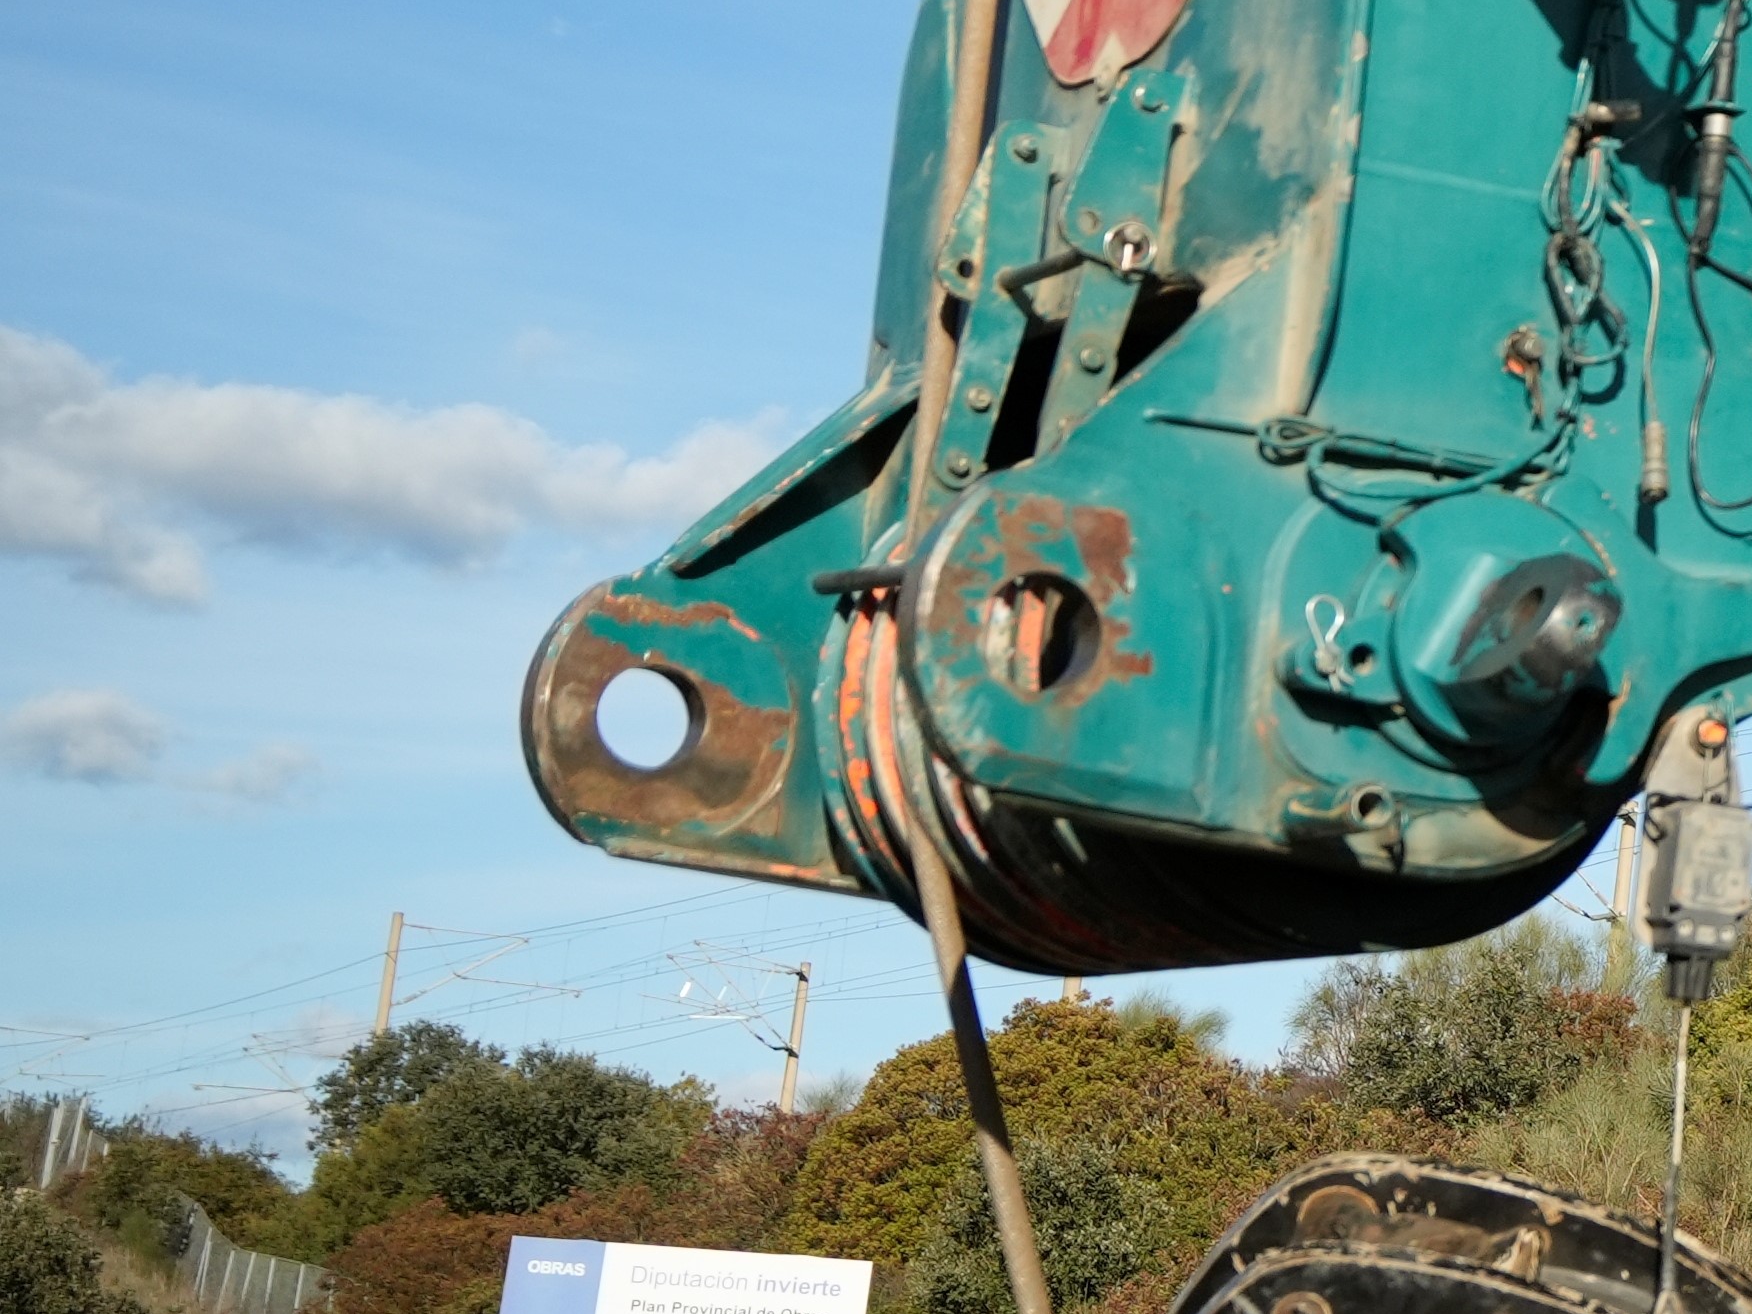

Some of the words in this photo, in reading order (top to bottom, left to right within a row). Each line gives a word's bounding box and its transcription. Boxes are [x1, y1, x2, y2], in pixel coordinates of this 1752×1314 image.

[527, 1260, 585, 1277] OBRAS
[630, 1264, 748, 1292] Diputación
[756, 1274, 842, 1298] invierte
[630, 1299, 666, 1314] Plan
